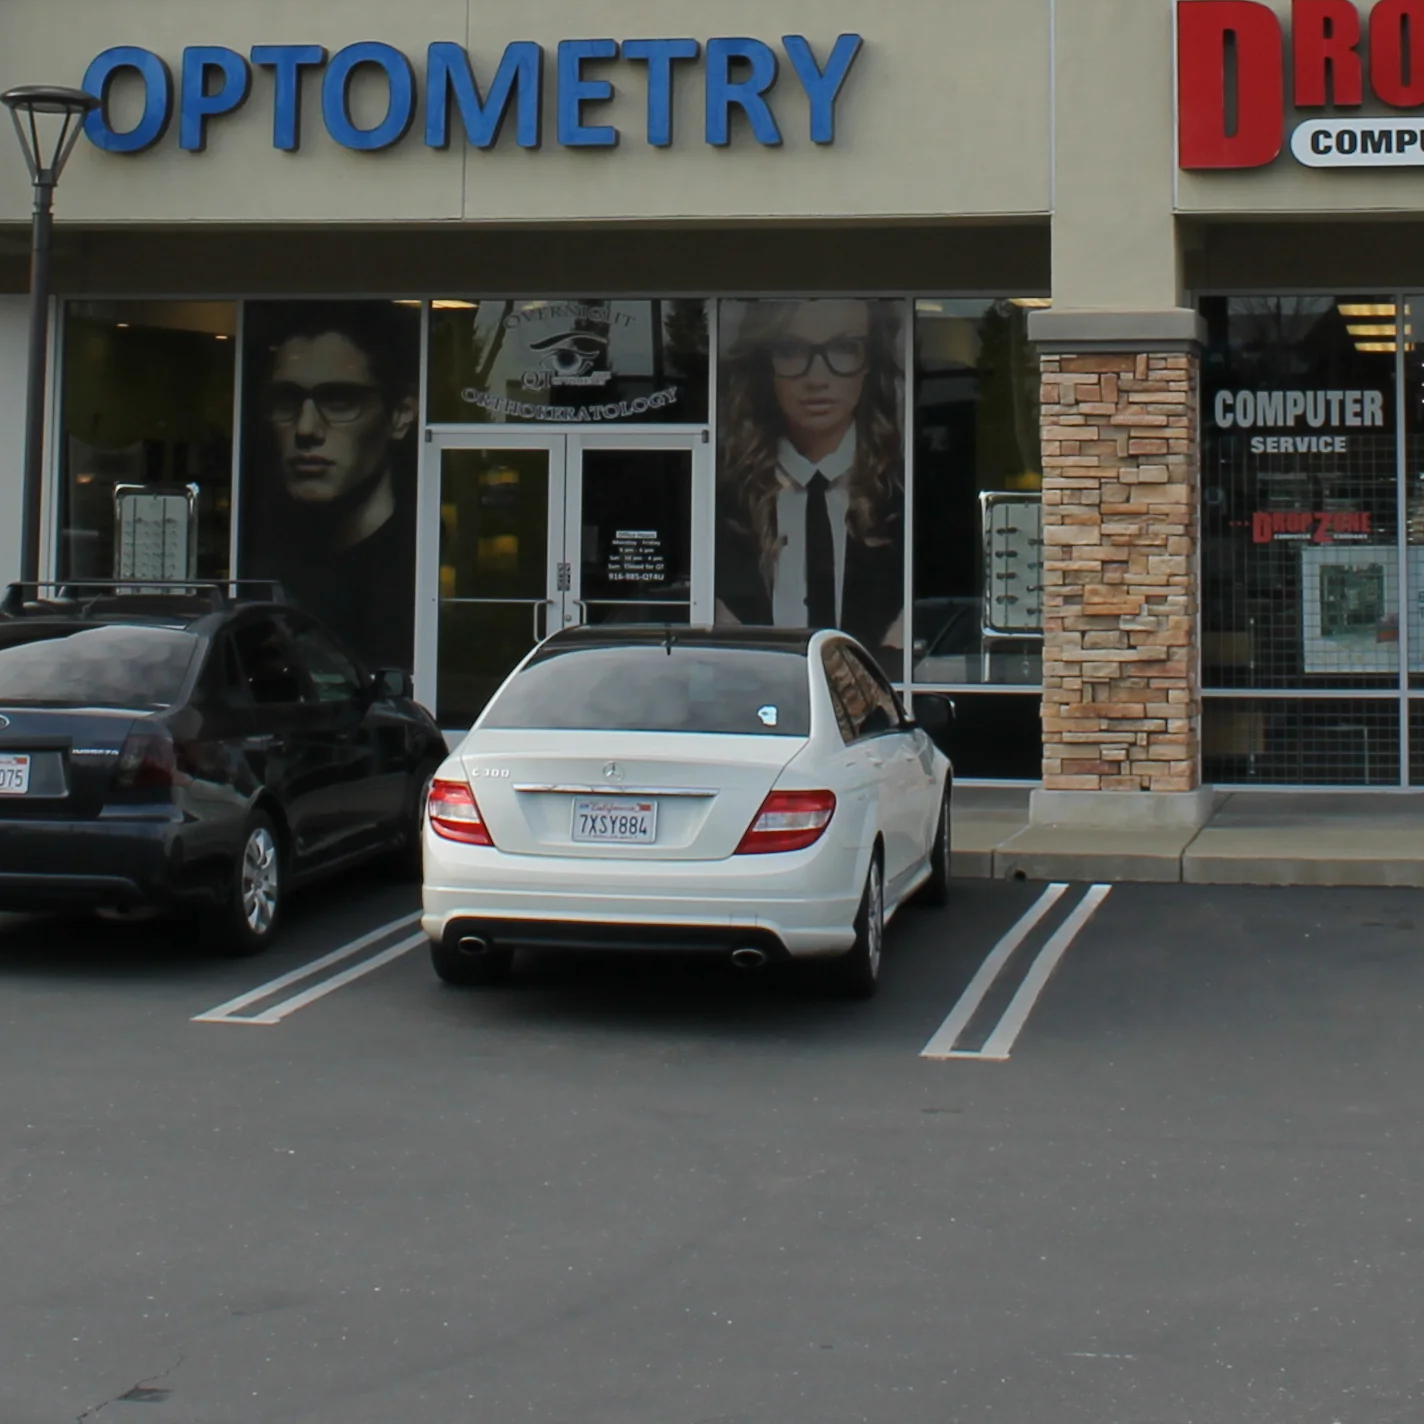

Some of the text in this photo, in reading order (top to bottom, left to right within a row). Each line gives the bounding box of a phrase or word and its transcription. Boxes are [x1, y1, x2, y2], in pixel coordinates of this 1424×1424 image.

[81, 33, 863, 153] OPTOMETRY
[503, 304, 637, 328] OVERNIGHT
[461, 386, 678, 422] ORTHOKERATOLOGY
[1214, 389, 1384, 428] COMPUTER
[1250, 436, 1348, 454] SERVICE
[589, 802, 638, 814] California
[579, 814, 649, 836] 7XSY884
